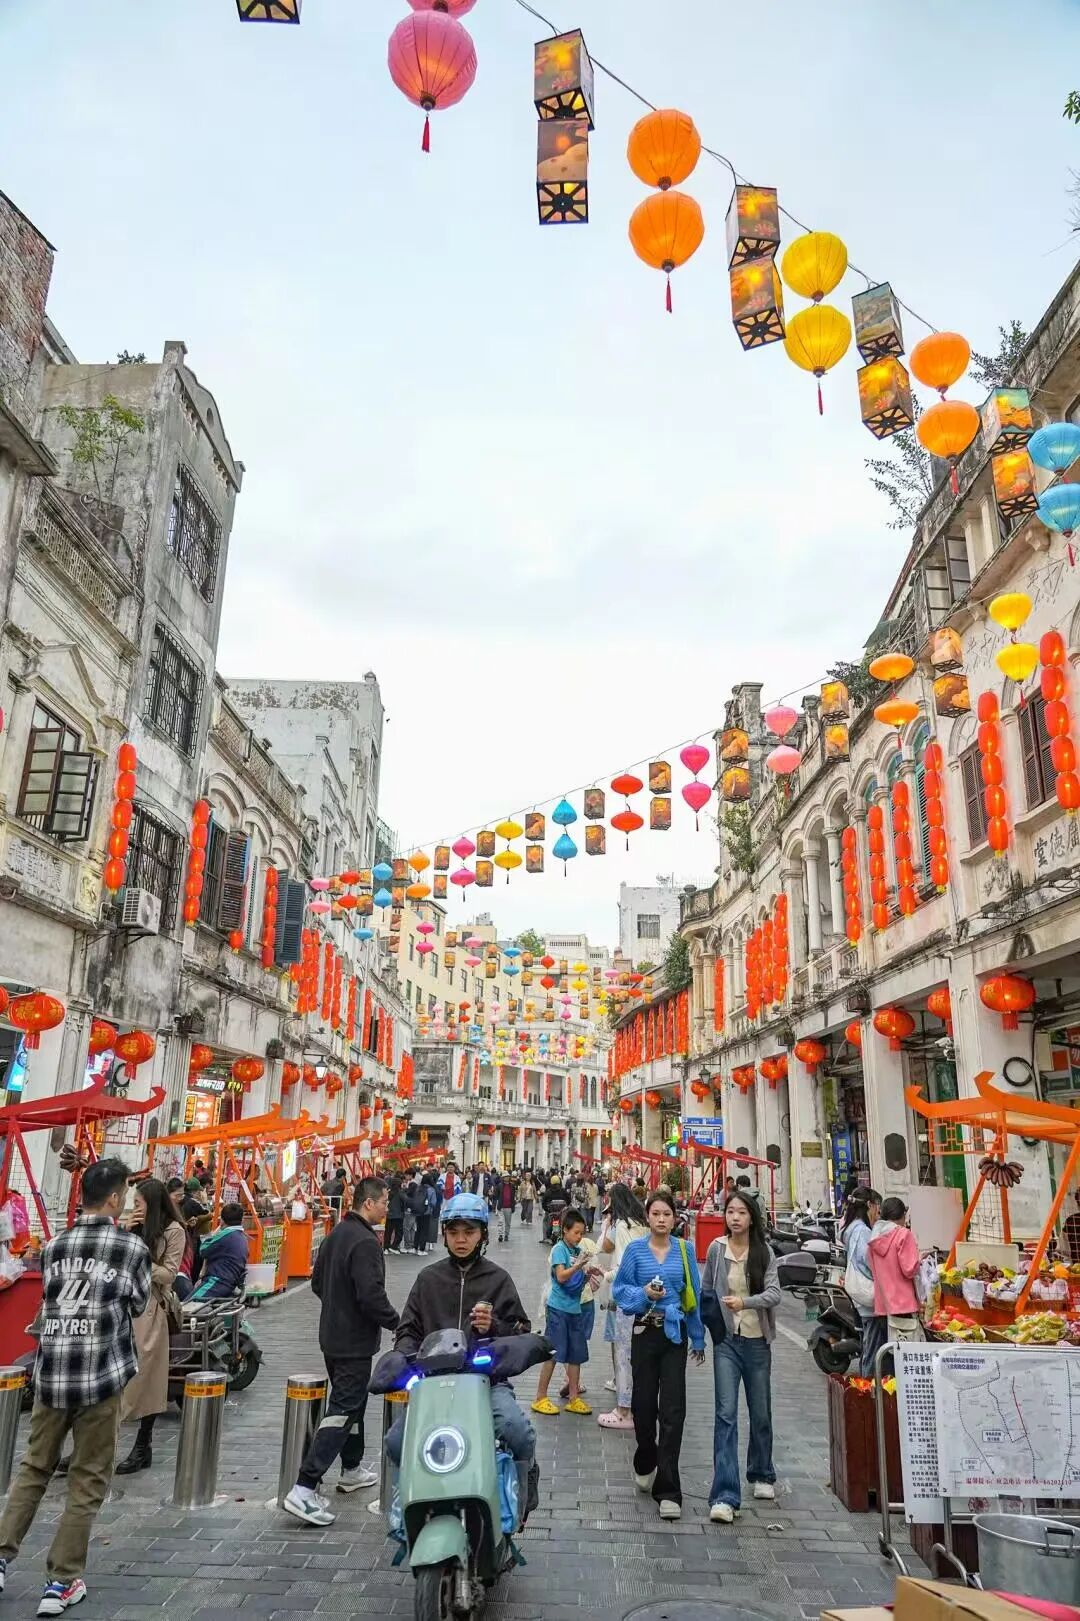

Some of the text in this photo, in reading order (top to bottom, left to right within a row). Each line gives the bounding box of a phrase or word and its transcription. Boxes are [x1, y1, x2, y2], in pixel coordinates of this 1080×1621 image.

[44, 1319, 97, 1335] HPYRST
[903, 1353, 932, 1362] 海口市龙华
